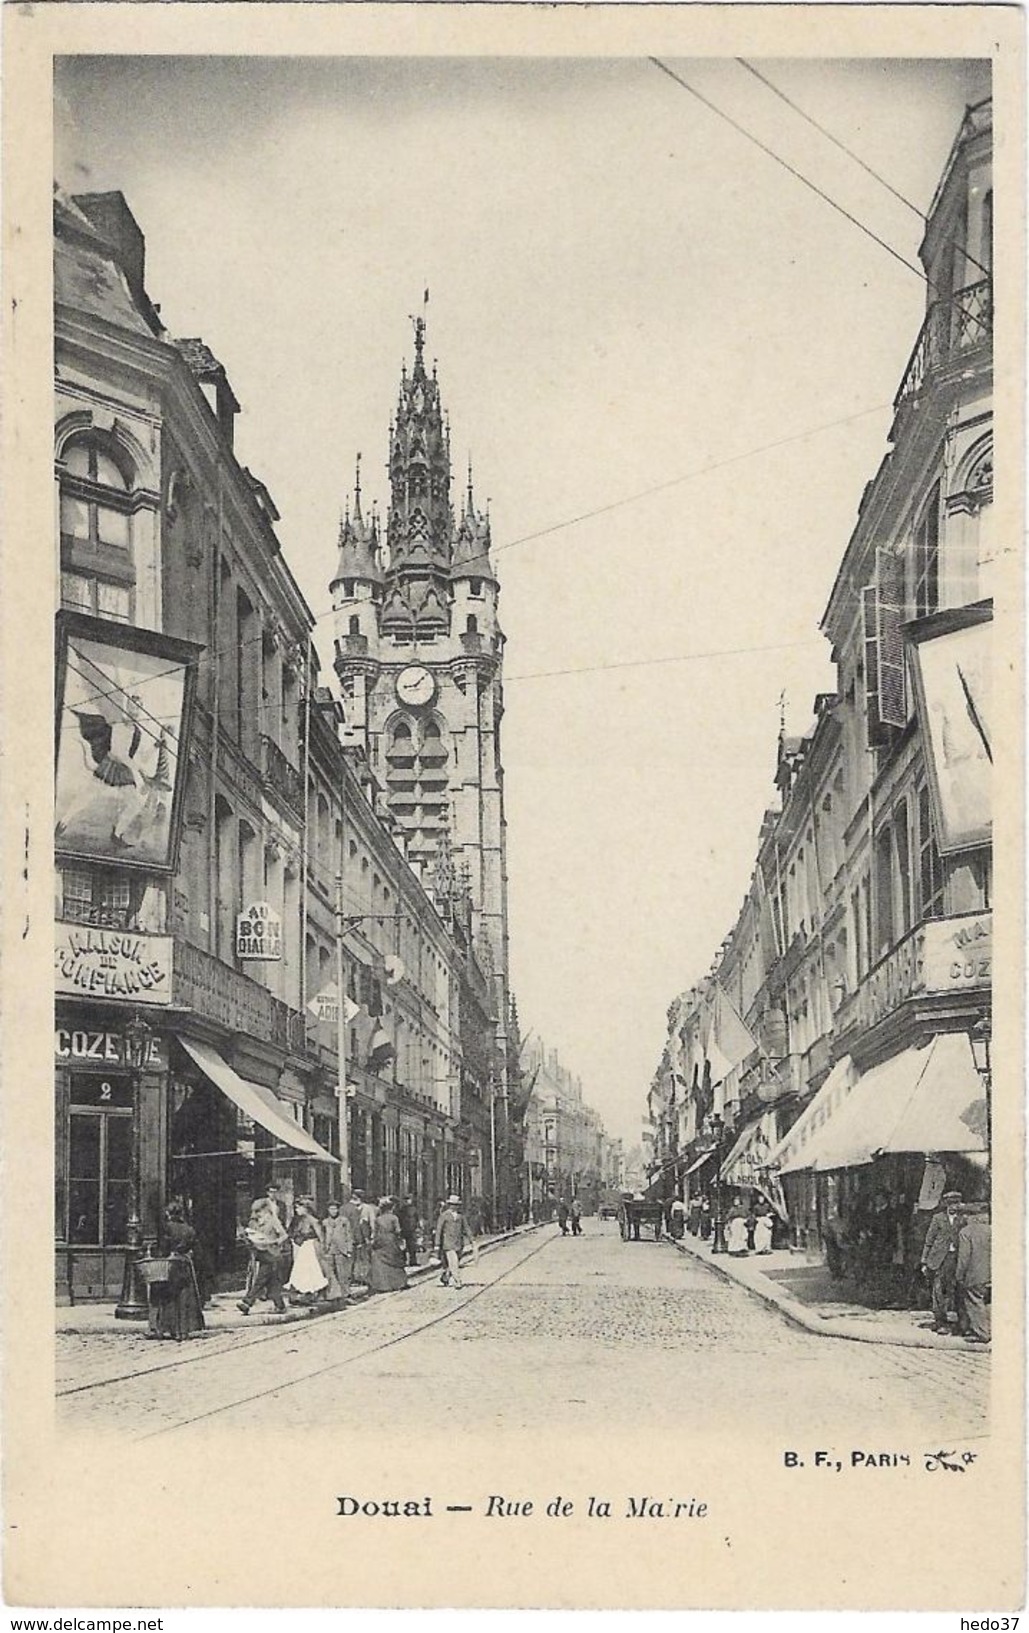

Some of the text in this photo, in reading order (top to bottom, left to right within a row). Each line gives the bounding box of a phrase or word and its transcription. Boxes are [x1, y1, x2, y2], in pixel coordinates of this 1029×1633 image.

[248, 906, 269, 919] AU
[240, 920, 279, 938] BON
[68, 930, 147, 965] MAISON
[55, 948, 166, 995] CONFIANCE
[100, 1082, 112, 1101] 2
